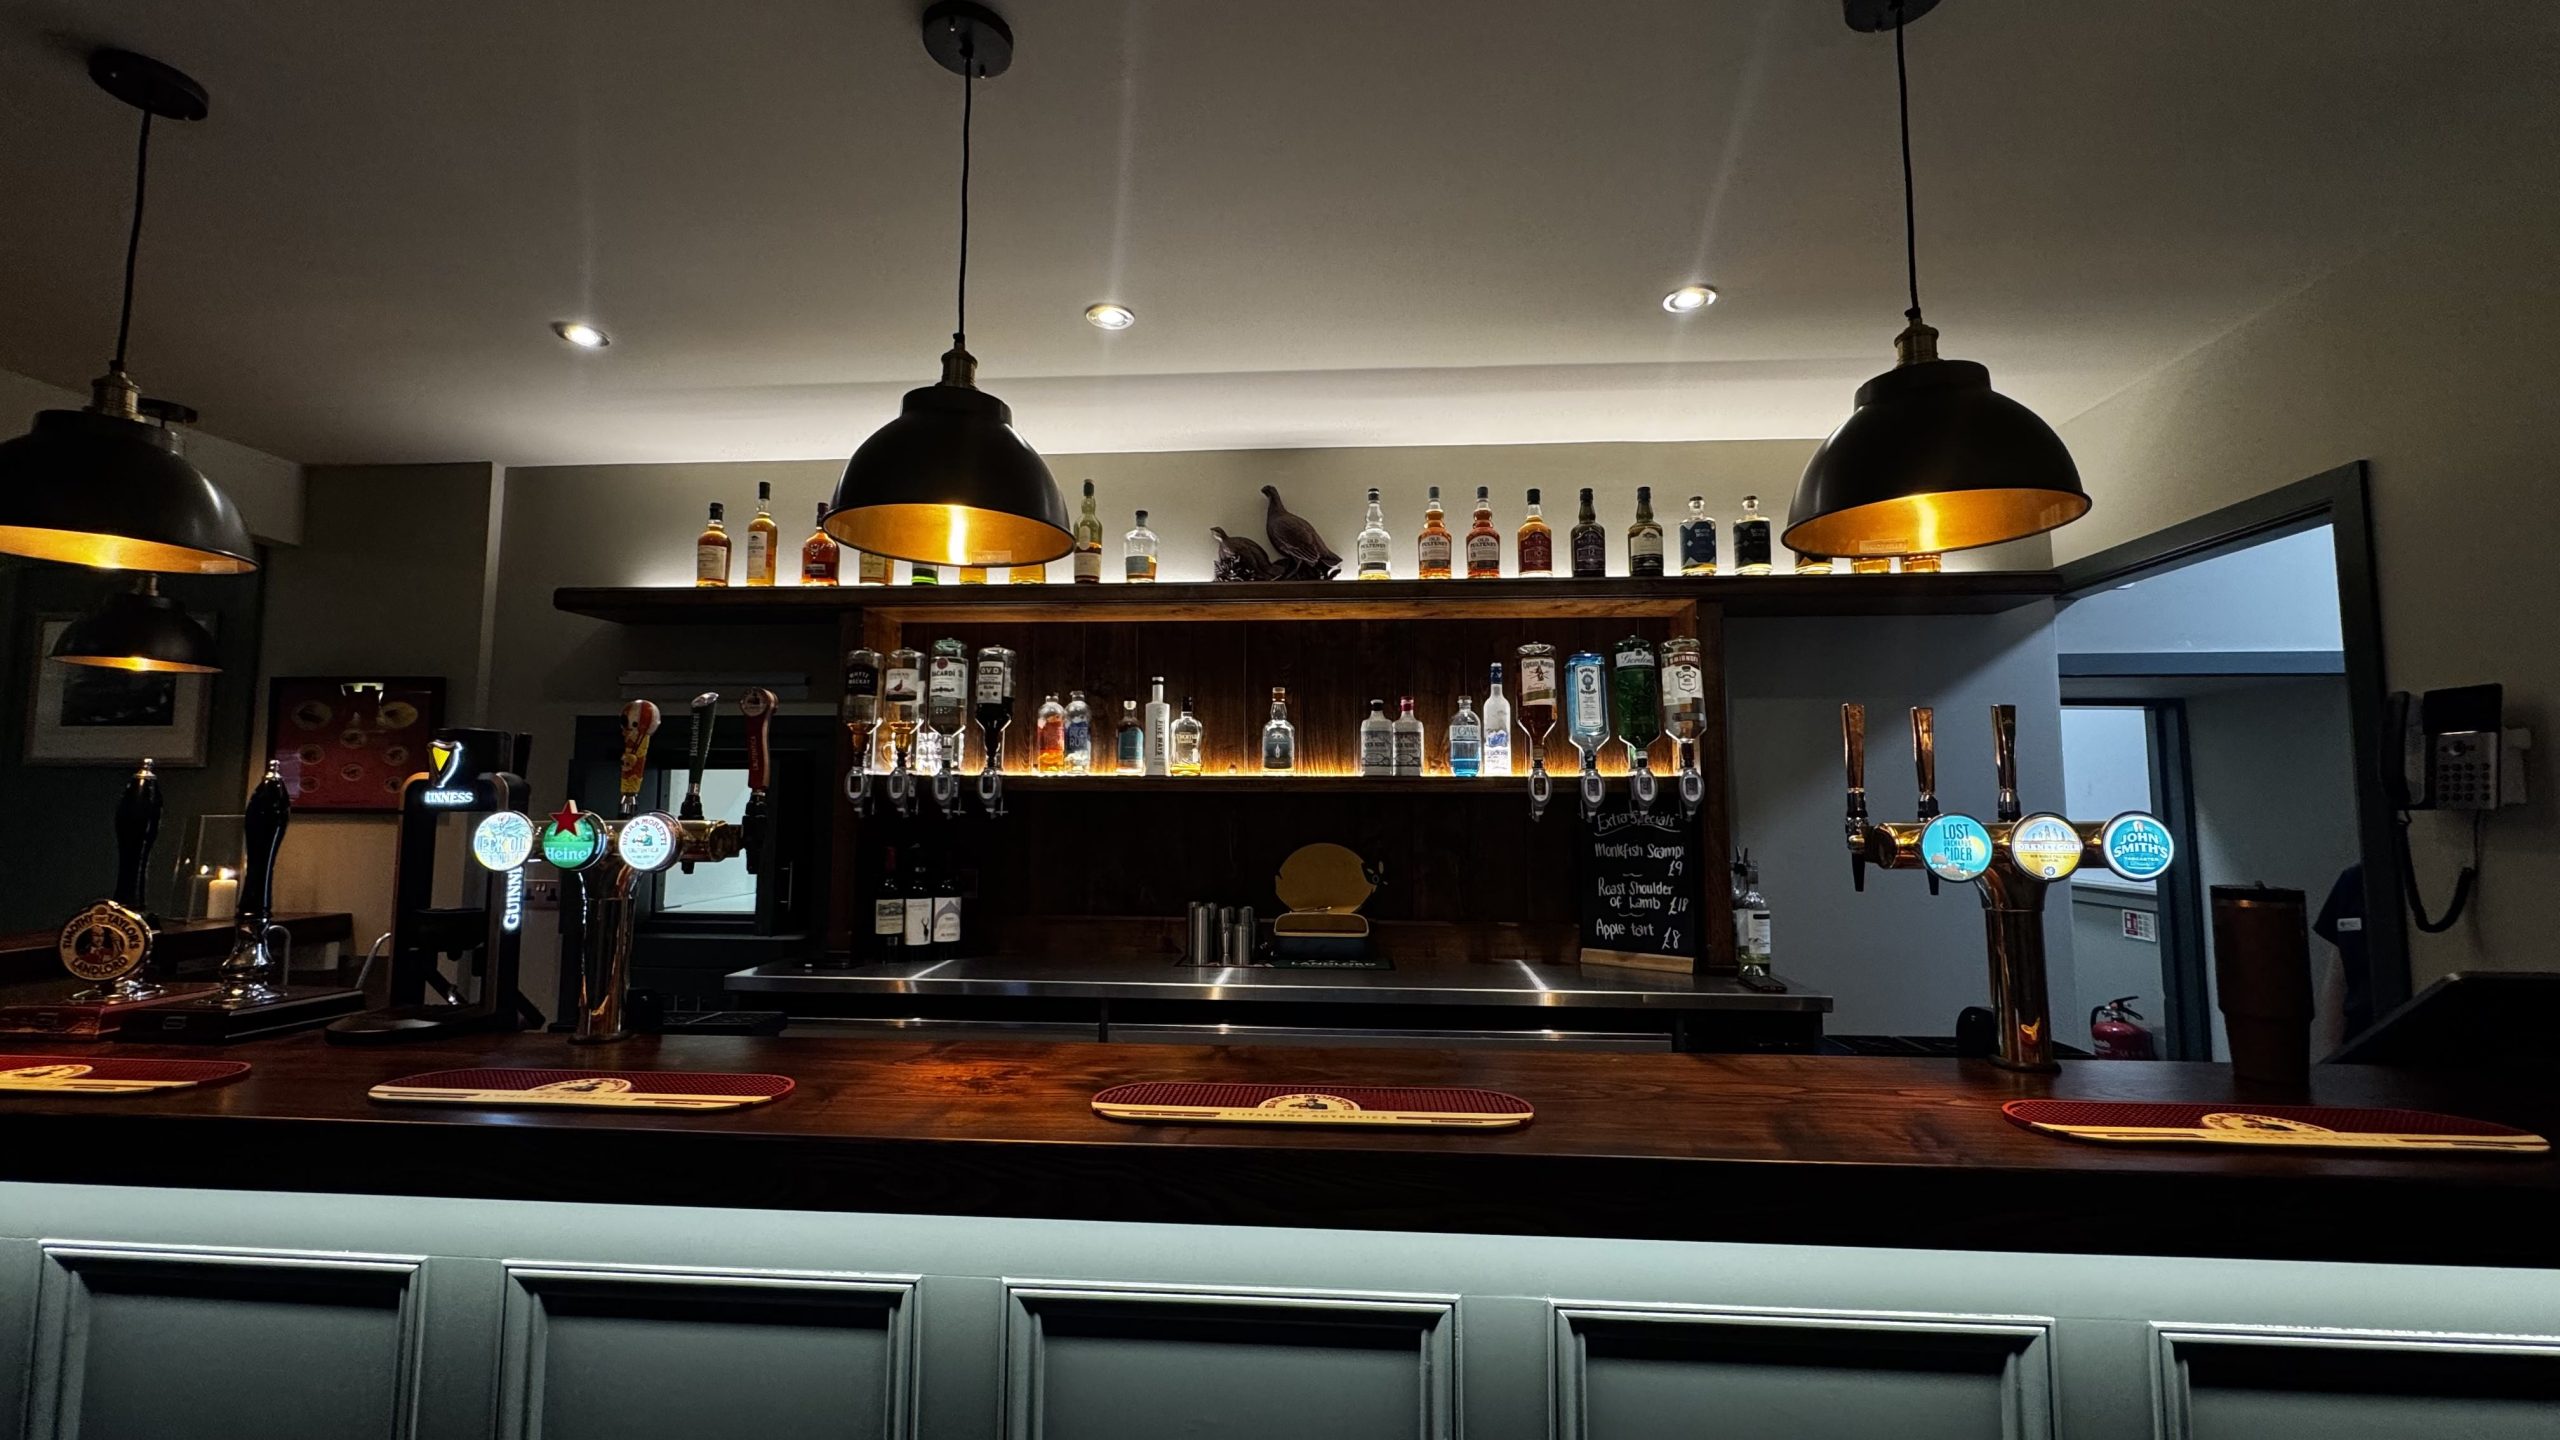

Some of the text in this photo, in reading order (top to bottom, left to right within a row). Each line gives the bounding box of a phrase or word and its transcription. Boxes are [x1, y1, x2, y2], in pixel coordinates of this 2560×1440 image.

[1597, 813, 1628, 832] Extra
[1942, 823, 1970, 840] LOST
[2120, 832, 2159, 845] JOHN
[545, 846, 592, 860] Heine
[1594, 842, 1685, 860] Monkfish Scampi
[1944, 847, 1973, 861] CIDER
[2113, 842, 2169, 859] SMITH'S
[1667, 860, 1684, 877] £9
[1598, 876, 1675, 897] Roast Shoulder
[502, 866, 524, 931] GUINN
[1609, 895, 1689, 916] of Lamb £18
[1596, 917, 1655, 941] Apple tart
[1661, 926, 1681, 950] £8
